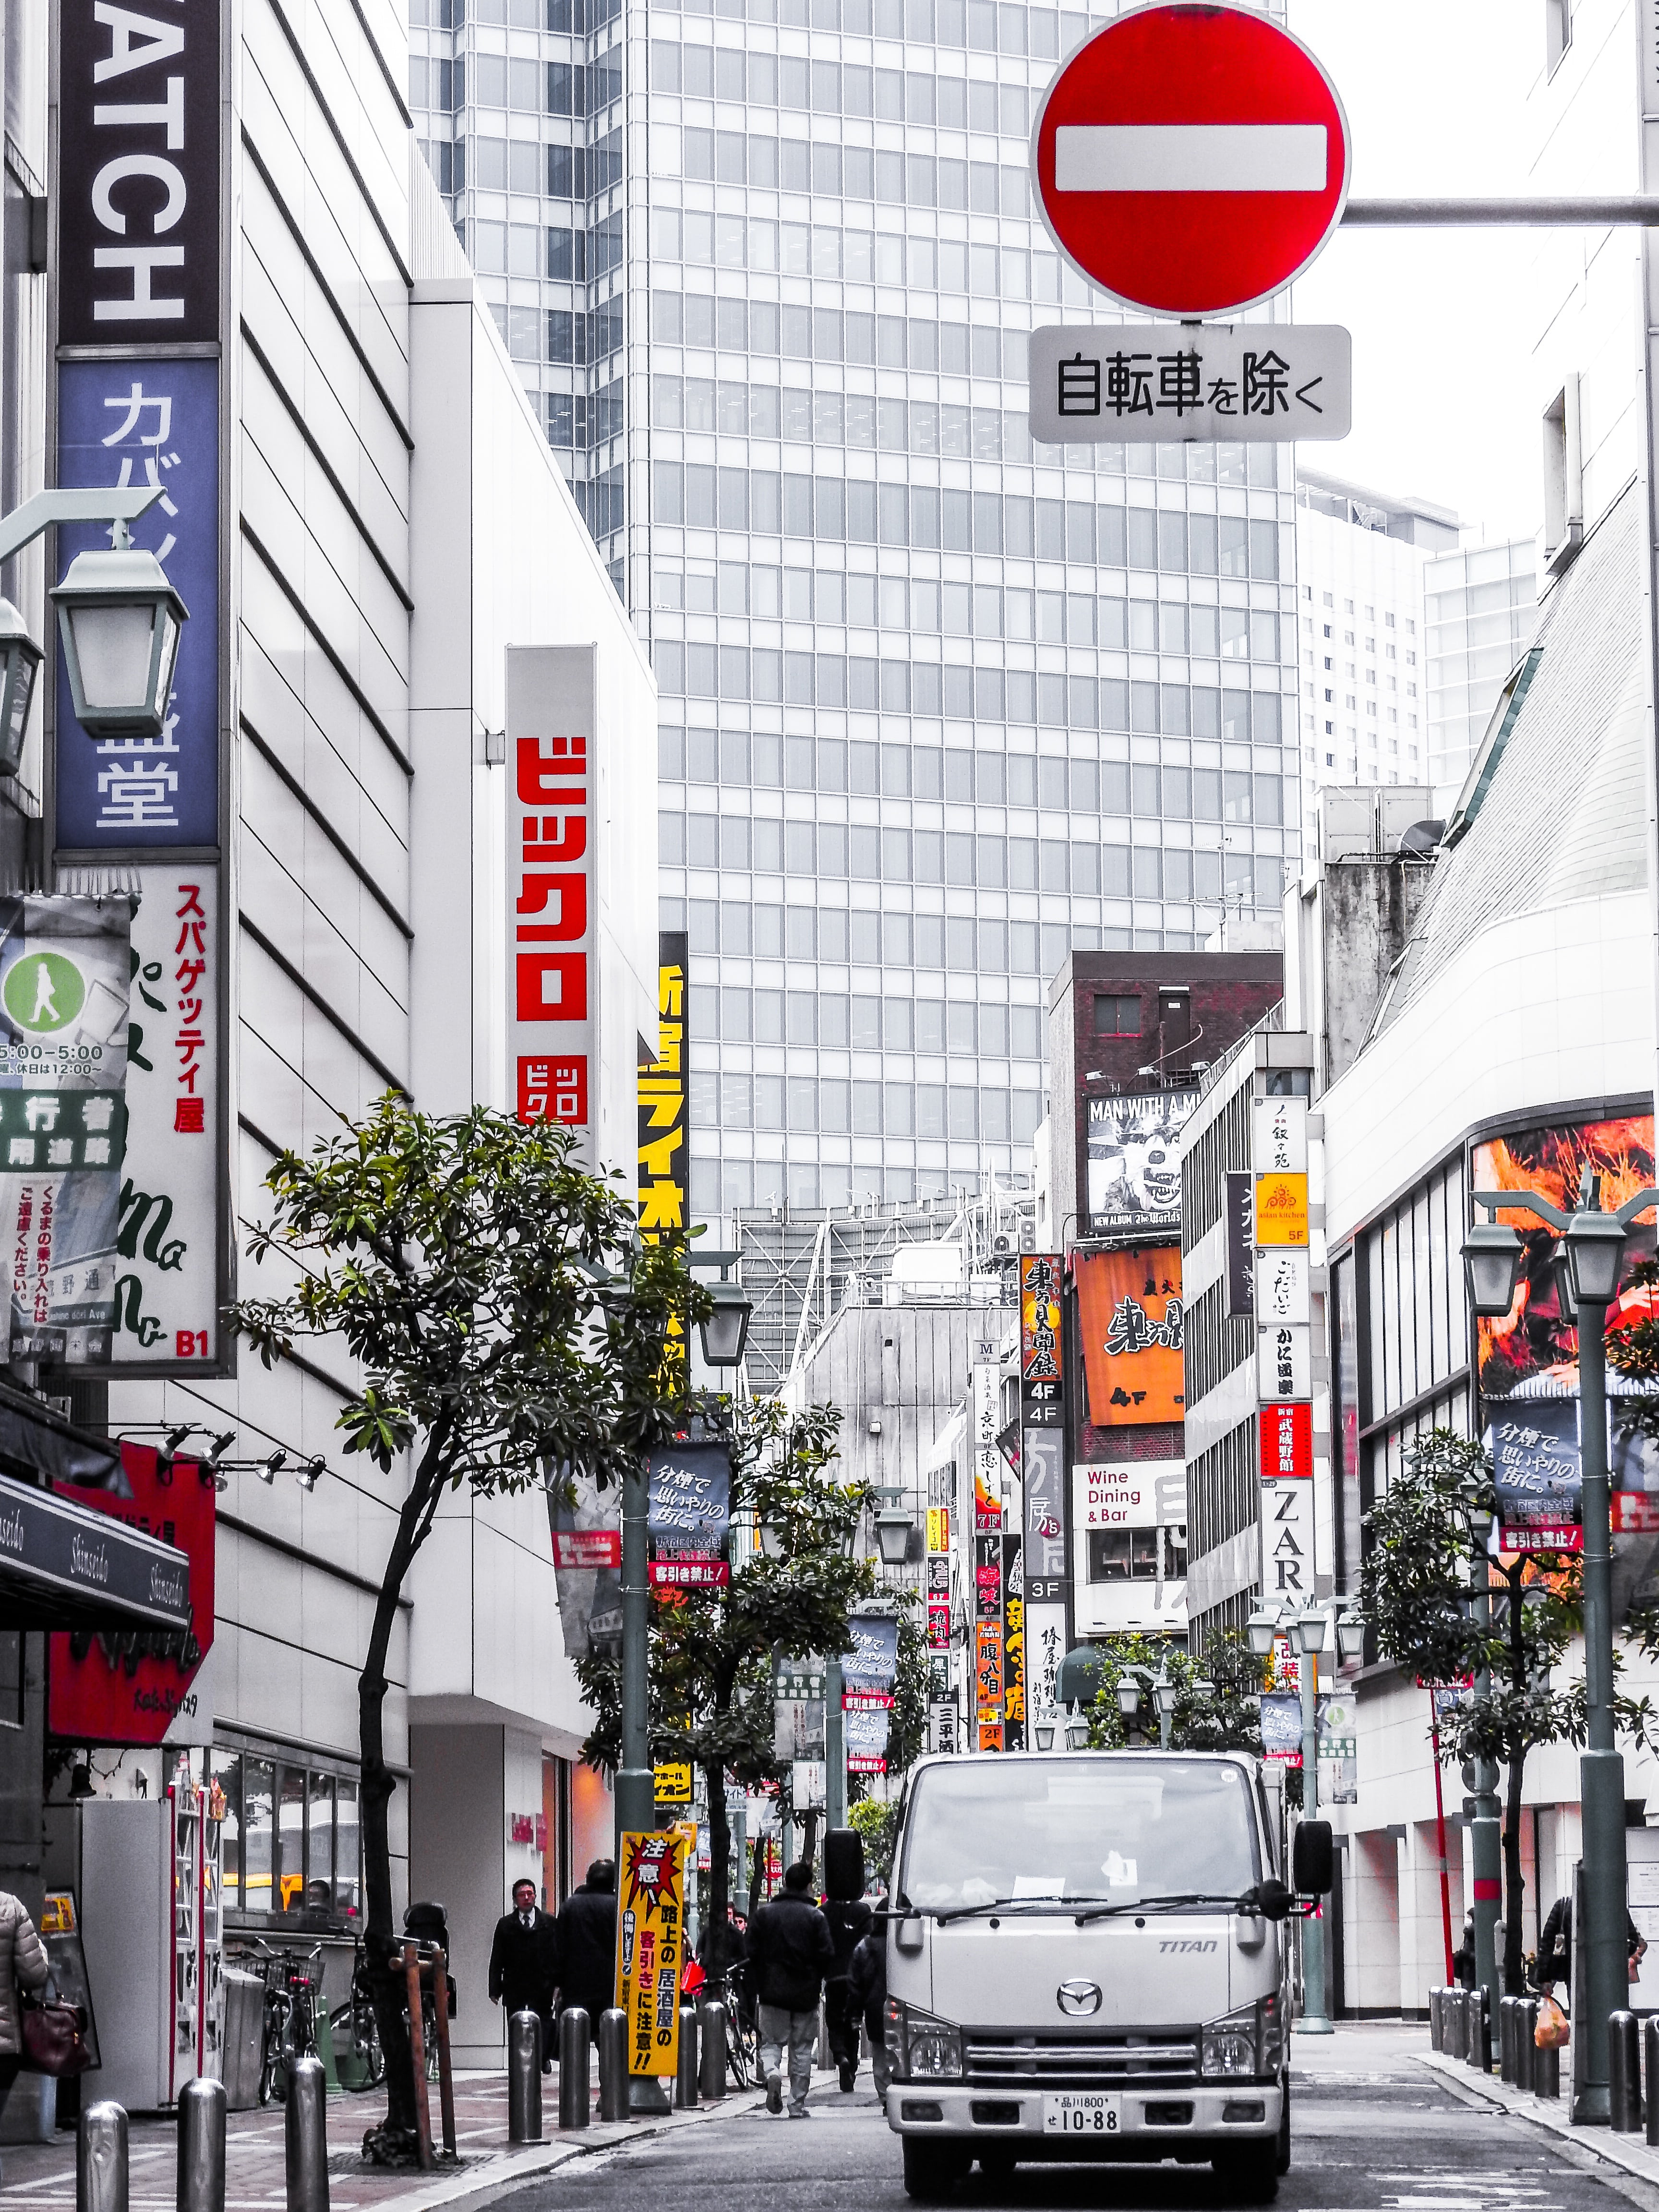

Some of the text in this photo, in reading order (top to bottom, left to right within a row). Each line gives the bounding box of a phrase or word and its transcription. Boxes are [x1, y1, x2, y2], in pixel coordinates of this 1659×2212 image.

[91, 0, 187, 320] ATCH
[1058, 350, 1323, 417] 自転車を除く
[1090, 1099, 1123, 1122] MAN
[1127, 1096, 1165, 1119] WITH
[1168, 1095, 1181, 1116] A
[1094, 1216, 1108, 1226] NEW
[1109, 1214, 1132, 1225] ALBUM
[1289, 1230, 1304, 1240] 5F
[176, 1330, 208, 1357] B1
[980, 1344, 993, 1354] M
[1031, 1382, 1055, 1400] 4F
[1109, 1387, 1147, 1407] 4F
[1030, 1407, 1057, 1421] 4F
[1278, 1418, 1294, 1472] 武蔵野館
[1497, 1422, 1560, 1453] 分煙で
[1498, 1444, 1575, 1479] 思いやりの
[653, 1464, 712, 1493] 分煙で
[1087, 1470, 1129, 1484] Wine
[654, 1484, 725, 1519] 思いやりの
[1088, 1489, 1141, 1504] Dining
[655, 1504, 695, 1532] 街に。
[977, 1514, 1000, 1528] 7F
[1088, 1508, 1128, 1522] & Bar
[71, 1533, 108, 1582] Shinseido
[656, 1565, 723, 1582] 客引き禁止!
[1032, 1582, 1059, 1598] 3F
[849, 1647, 893, 1668] いやりの
[979, 1643, 1000, 1695] 腹八分目
[985, 1729, 1000, 1739] 2F
[1159, 1941, 1217, 1953] TITAN
[656, 1904, 678, 2046] 路上の居酒屋の
[1063, 2110, 1117, 2130] 10-88
